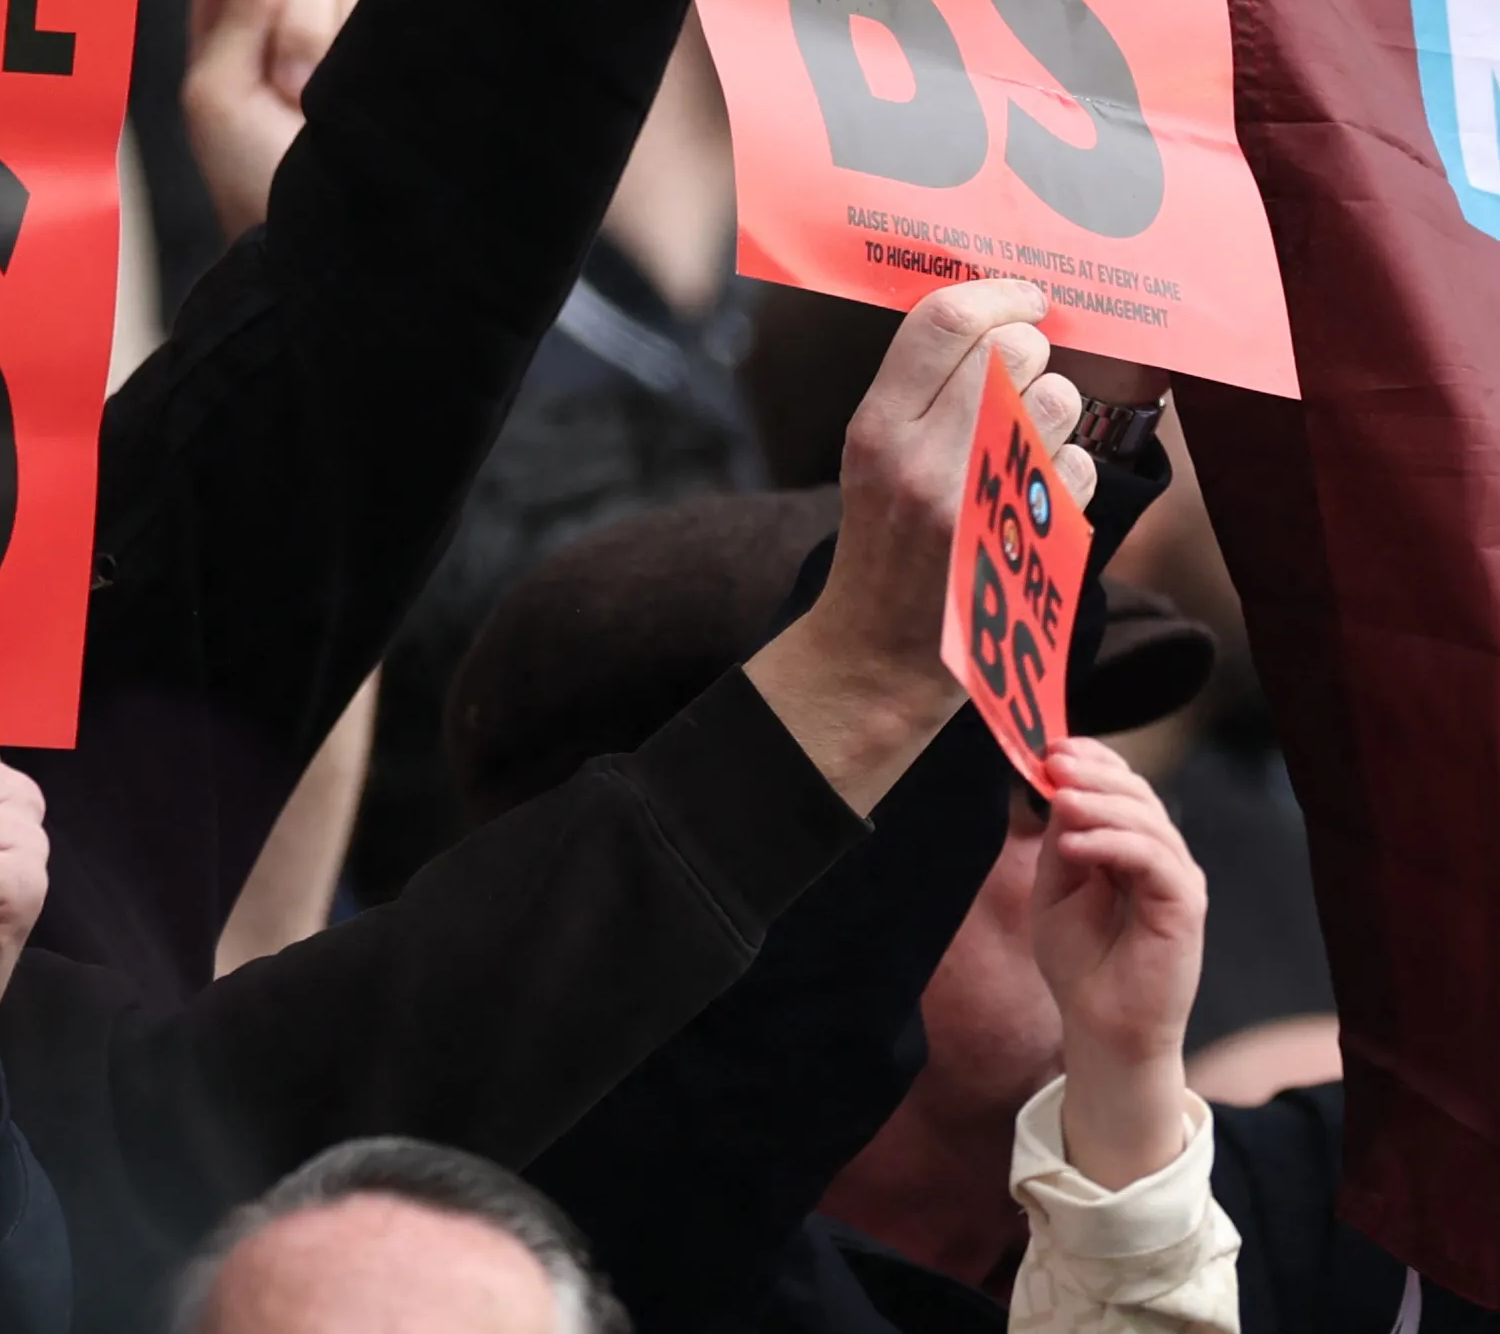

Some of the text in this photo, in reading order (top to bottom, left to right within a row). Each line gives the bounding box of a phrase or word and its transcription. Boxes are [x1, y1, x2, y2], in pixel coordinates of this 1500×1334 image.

[847, 206, 889, 233] RAISE
[892, 214, 931, 242] YOUR
[934, 224, 970, 250] CARD
[974, 234, 994, 254] ON
[999, 239, 1014, 261] 15
[1015, 243, 1076, 276] MINUTES
[1079, 257, 1095, 278] AT
[1097, 263, 1140, 291] EVERY
[1143, 275, 1182, 302] GAME
[865, 241, 884, 264] TO
[887, 245, 963, 283] HIGHLIGHT
[1051, 283, 1169, 328] MISMANAGEMENT
[1006, 420, 1051, 538] NO
[975, 448, 1062, 649] MORE
[970, 542, 1046, 760] BS
